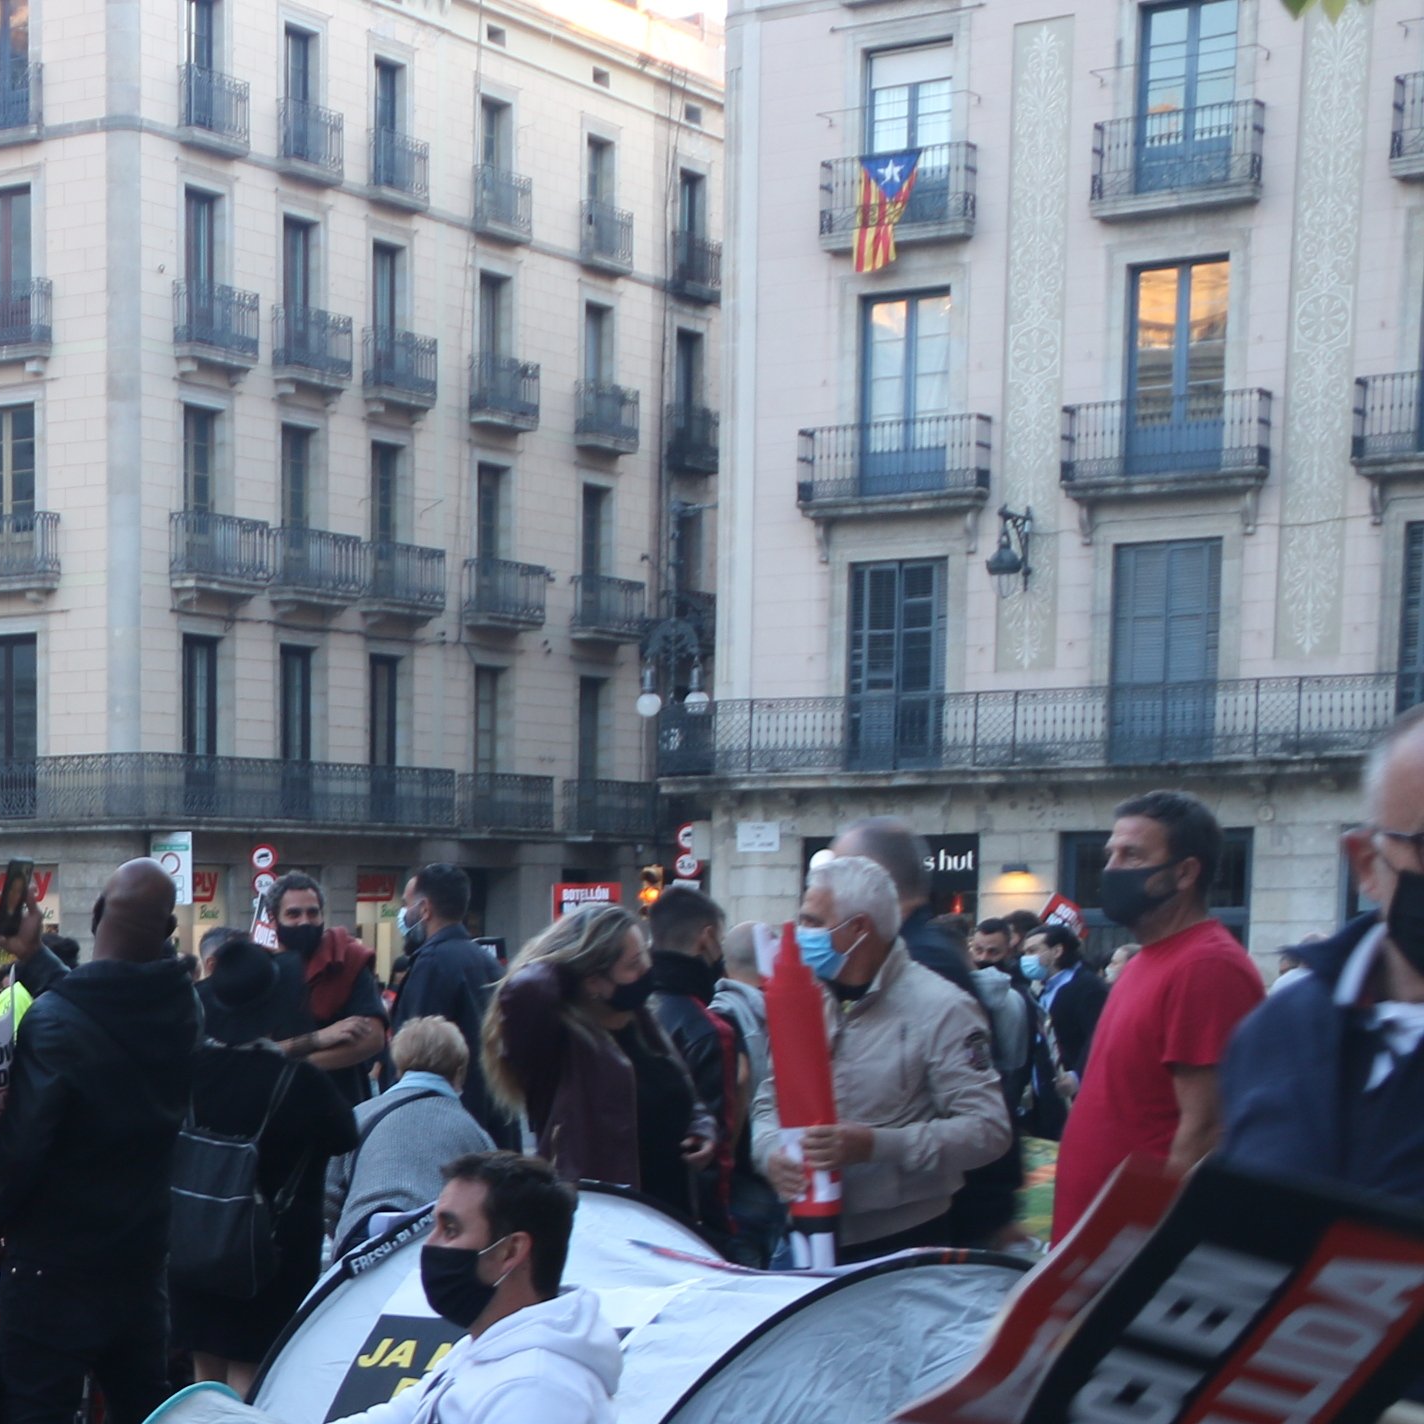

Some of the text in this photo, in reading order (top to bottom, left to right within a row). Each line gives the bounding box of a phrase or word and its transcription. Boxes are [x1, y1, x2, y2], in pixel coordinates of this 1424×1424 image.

[923, 848, 975, 872] s hut
[562, 885, 609, 901] BOTELLÓN
[358, 1338, 418, 1369] JA
